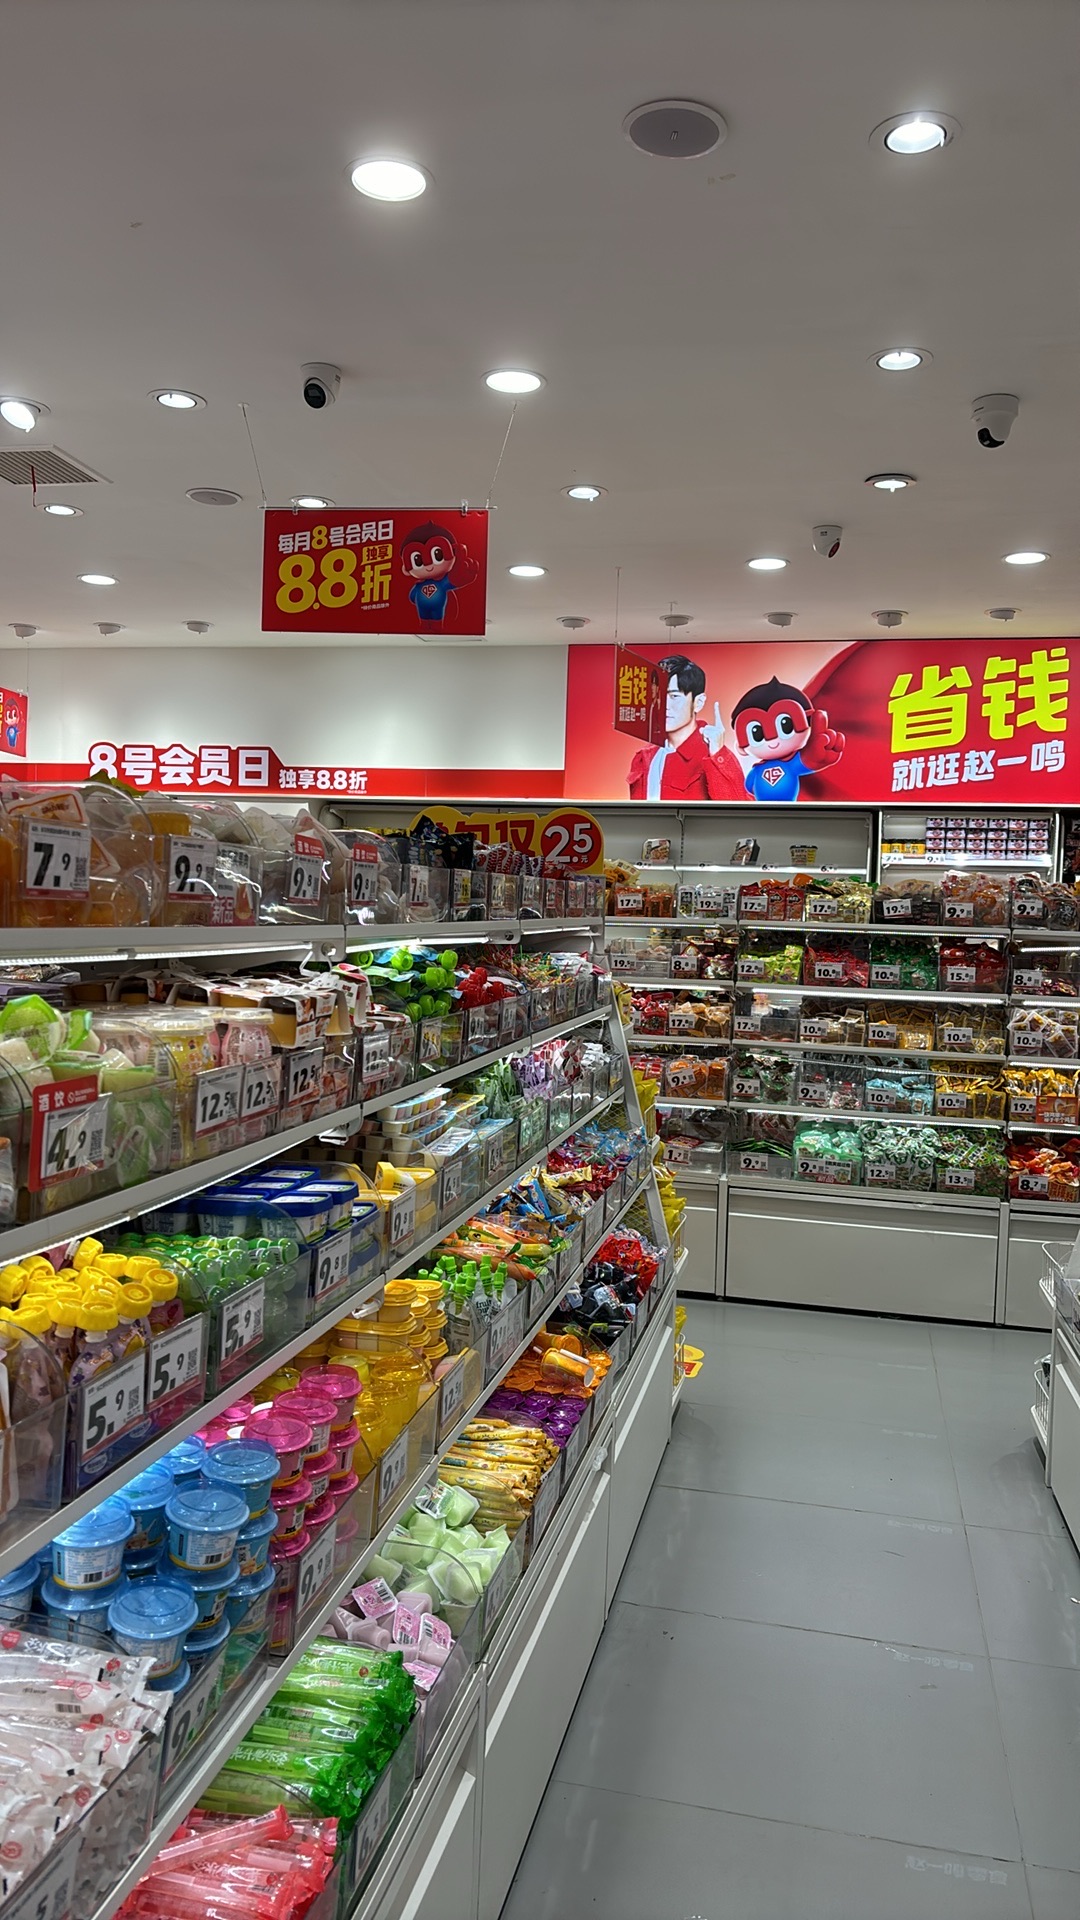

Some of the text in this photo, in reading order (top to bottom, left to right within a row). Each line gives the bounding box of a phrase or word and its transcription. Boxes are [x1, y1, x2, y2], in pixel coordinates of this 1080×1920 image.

[278, 519, 394, 554] 每月8号会员日
[366, 545, 390, 561] 独享
[619, 664, 647, 705] 省钱
[619, 706, 647, 722] 就逛赵一鸣
[888, 647, 1070, 753] 省钱
[90, 744, 270, 786] 8号会员日
[278, 768, 368, 790] 独享8.8折
[891, 739, 1066, 792] 就逛赵一鸣
[33, 842, 71, 887] 7.9
[174, 854, 203, 893] 9.9
[293, 867, 313, 897] 9.8
[354, 872, 370, 900] 9.8
[886, 905, 904, 914] 19.5
[947, 906, 965, 919] 9.9
[1017, 904, 1035, 915] 9.9
[673, 961, 689, 971] 8.8
[1014, 975, 1032, 986] 8.8
[292, 1065, 316, 1095] 12.5
[736, 1084, 752, 1094] 9.9
[800, 1088, 817, 1098] 9.9
[201, 1091, 231, 1124] 12.5
[246, 1081, 272, 1109] 12.5
[47, 1129, 87, 1171] 4.9
[667, 1150, 682, 1160] 1.7
[743, 1158, 760, 1168] 9.9
[870, 1169, 889, 1178] 12.5
[948, 1175, 967, 1184] 13.5
[1020, 1180, 1038, 1191] 8.7
[393, 1212, 408, 1241] 9.8
[320, 1256, 340, 1291] 9.8
[225, 1309, 251, 1358] 5.9
[152, 1353, 185, 1400] 5.9
[444, 1382, 460, 1415] 12.5
[86, 1389, 125, 1450] 5.9
[383, 1459, 400, 1500] 9.9
[301, 1558, 323, 1605] 9.9
